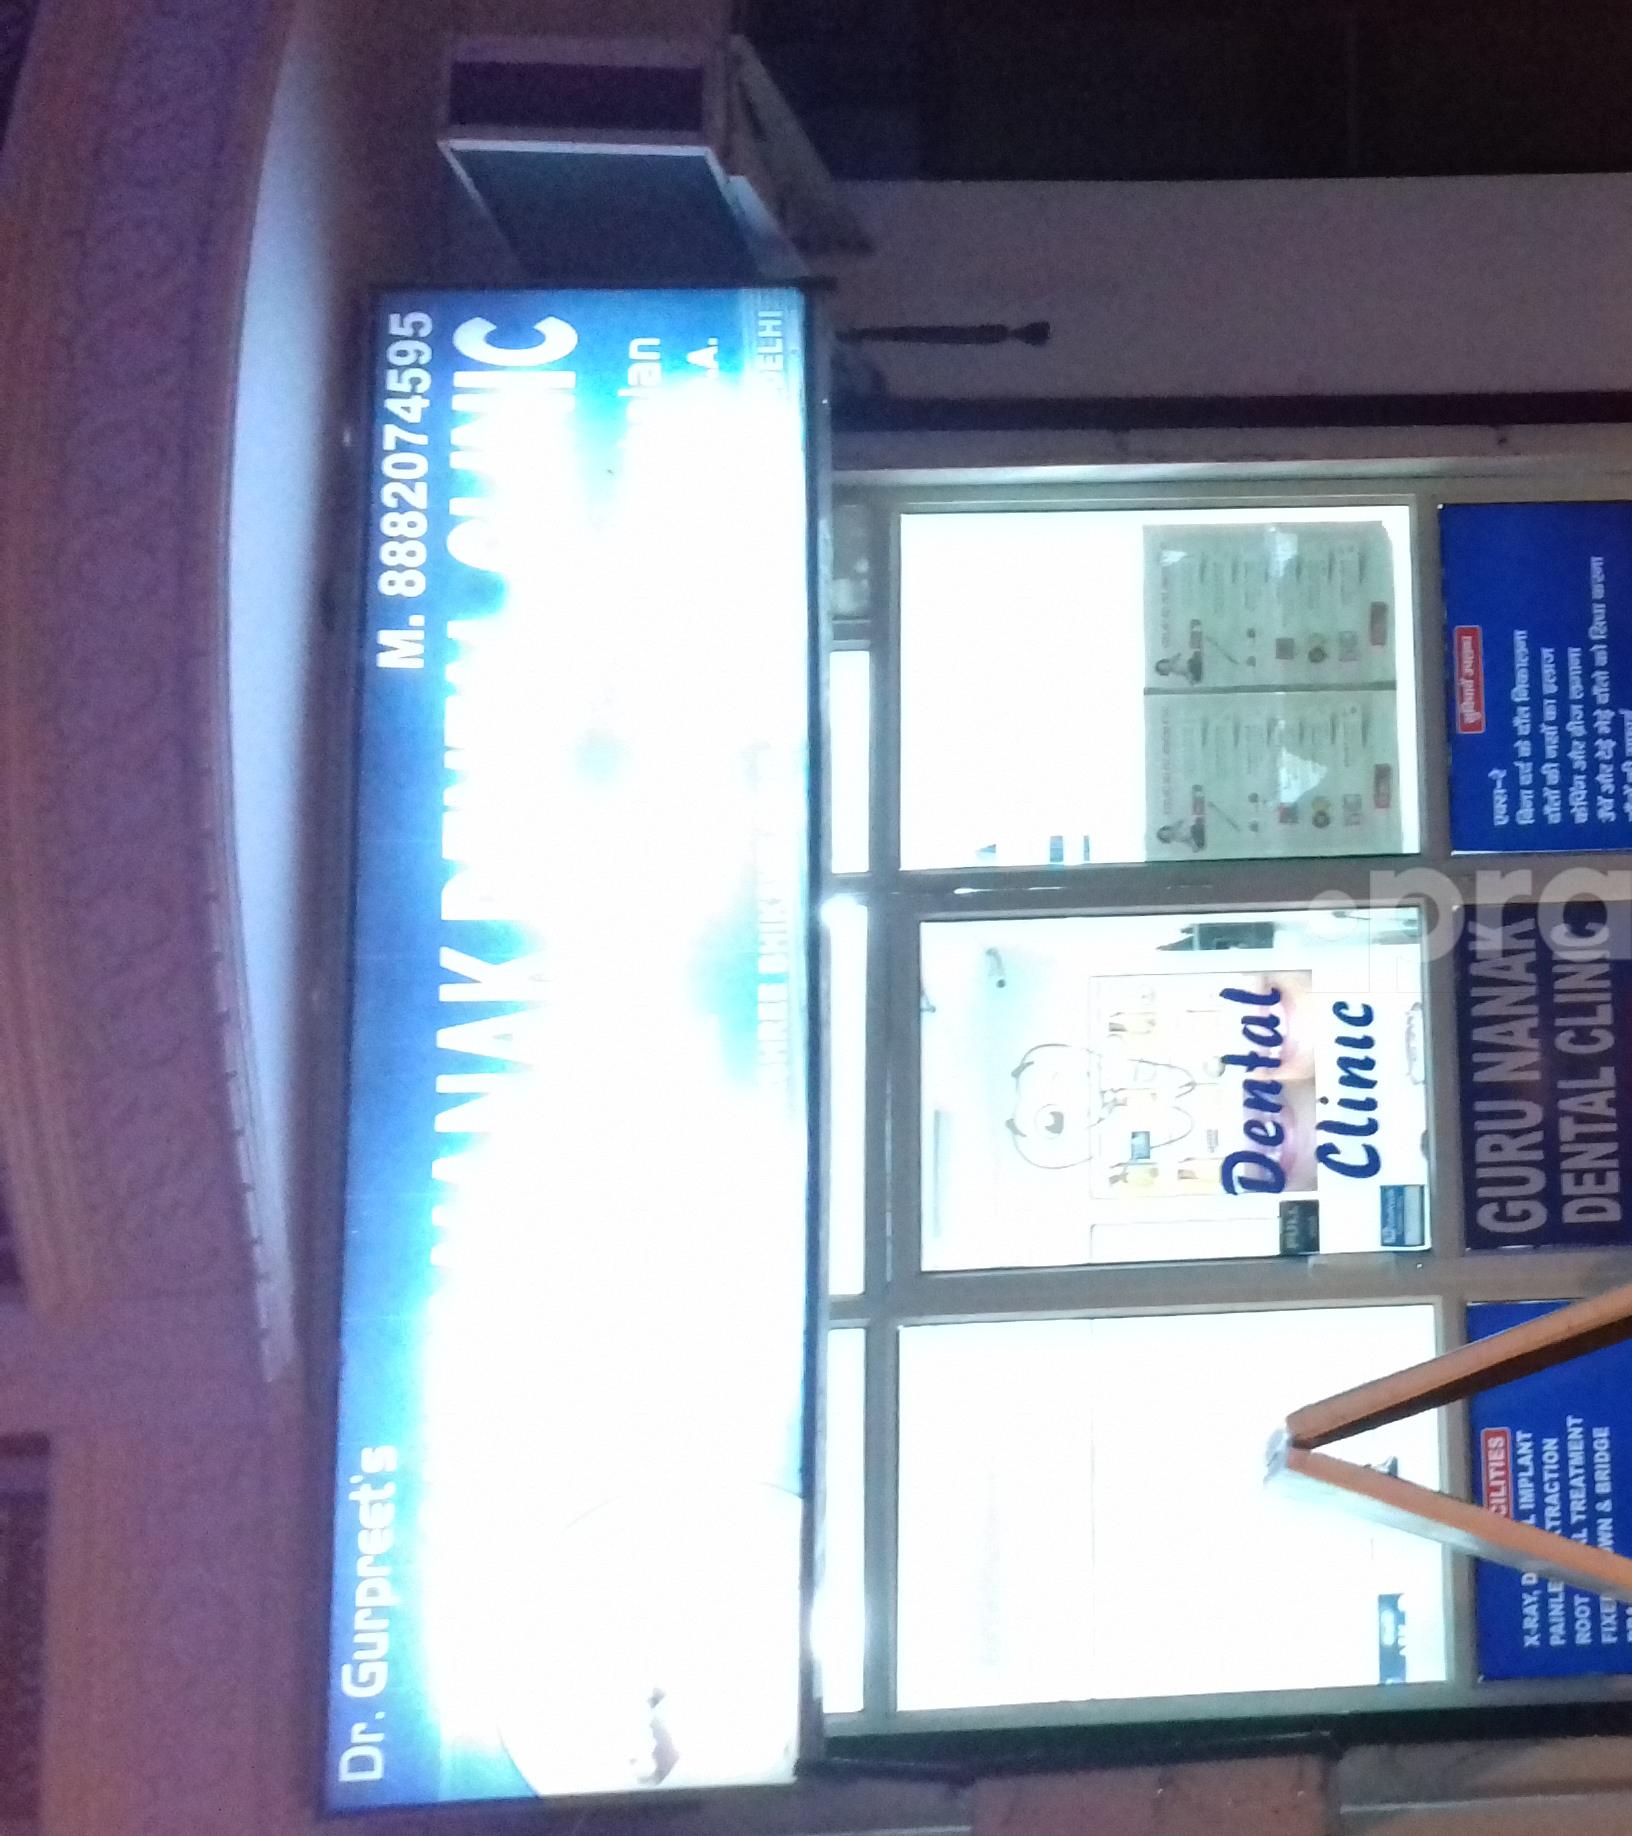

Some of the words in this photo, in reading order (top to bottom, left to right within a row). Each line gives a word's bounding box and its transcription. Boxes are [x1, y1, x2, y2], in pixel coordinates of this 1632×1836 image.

[379, 311, 432, 597] 8882074595
[377, 615, 426, 670] M.
[1469, 918, 1542, 1083] NANAK
[1552, 922, 1615, 1054] CLINIC
[1219, 987, 1287, 1195] Dental
[1316, 1001, 1381, 1179] Clinic
[1473, 1098, 1548, 1233] GURU
[1557, 1067, 1621, 1223] DENTAL
[1487, 1437, 1507, 1516] CILITIES
[1516, 1430, 1535, 1510] IMPLANT
[1542, 1438, 1562, 1536] TRACTION
[1566, 1415, 1587, 1523] TREATMENT
[1592, 1426, 1611, 1493] BRIDGE
[1595, 1499, 1613, 1513] &
[342, 1445, 399, 1697] Gurpreet's
[1547, 1581, 1566, 1647] PAINLE
[1522, 1589, 1541, 1647] X-RAY,
[1574, 1594, 1592, 1645] ROOT
[1600, 1595, 1618, 1644] FIXE
[340, 1711, 385, 1781] Dr.
